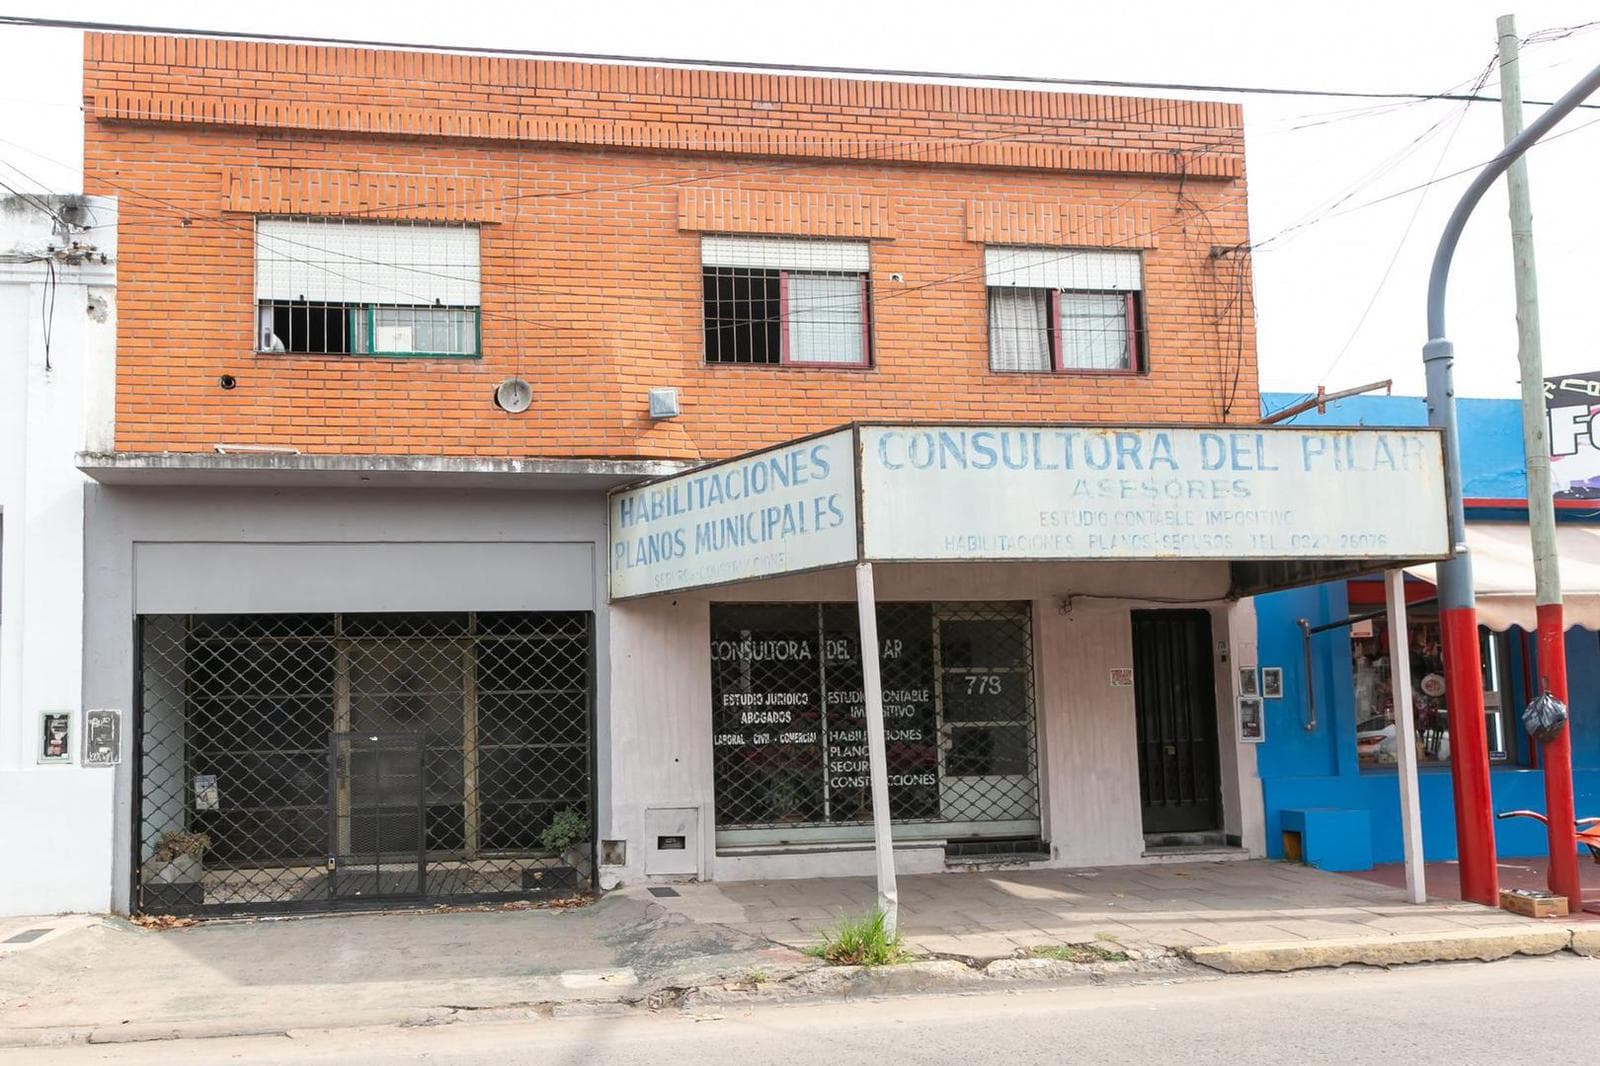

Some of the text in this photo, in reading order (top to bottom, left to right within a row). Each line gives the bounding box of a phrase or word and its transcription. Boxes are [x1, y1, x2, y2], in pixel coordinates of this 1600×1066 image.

[878, 431, 1426, 472] CONSULTORA DEL PILAR
[620, 444, 832, 528] HABILITACIONES
[1071, 478, 1253, 500] ASESORES
[1039, 510, 1109, 527] ESTUDIO
[614, 493, 846, 571] PLANOS MUNICIPALES
[711, 639, 851, 661] CONSULTORA DEL
[723, 693, 763, 706] ESTUDIO
[827, 689, 930, 704] ESTUDI ONTABLE
[740, 711, 792, 724] ABOGADOS
[830, 760, 871, 773] SEGUR
